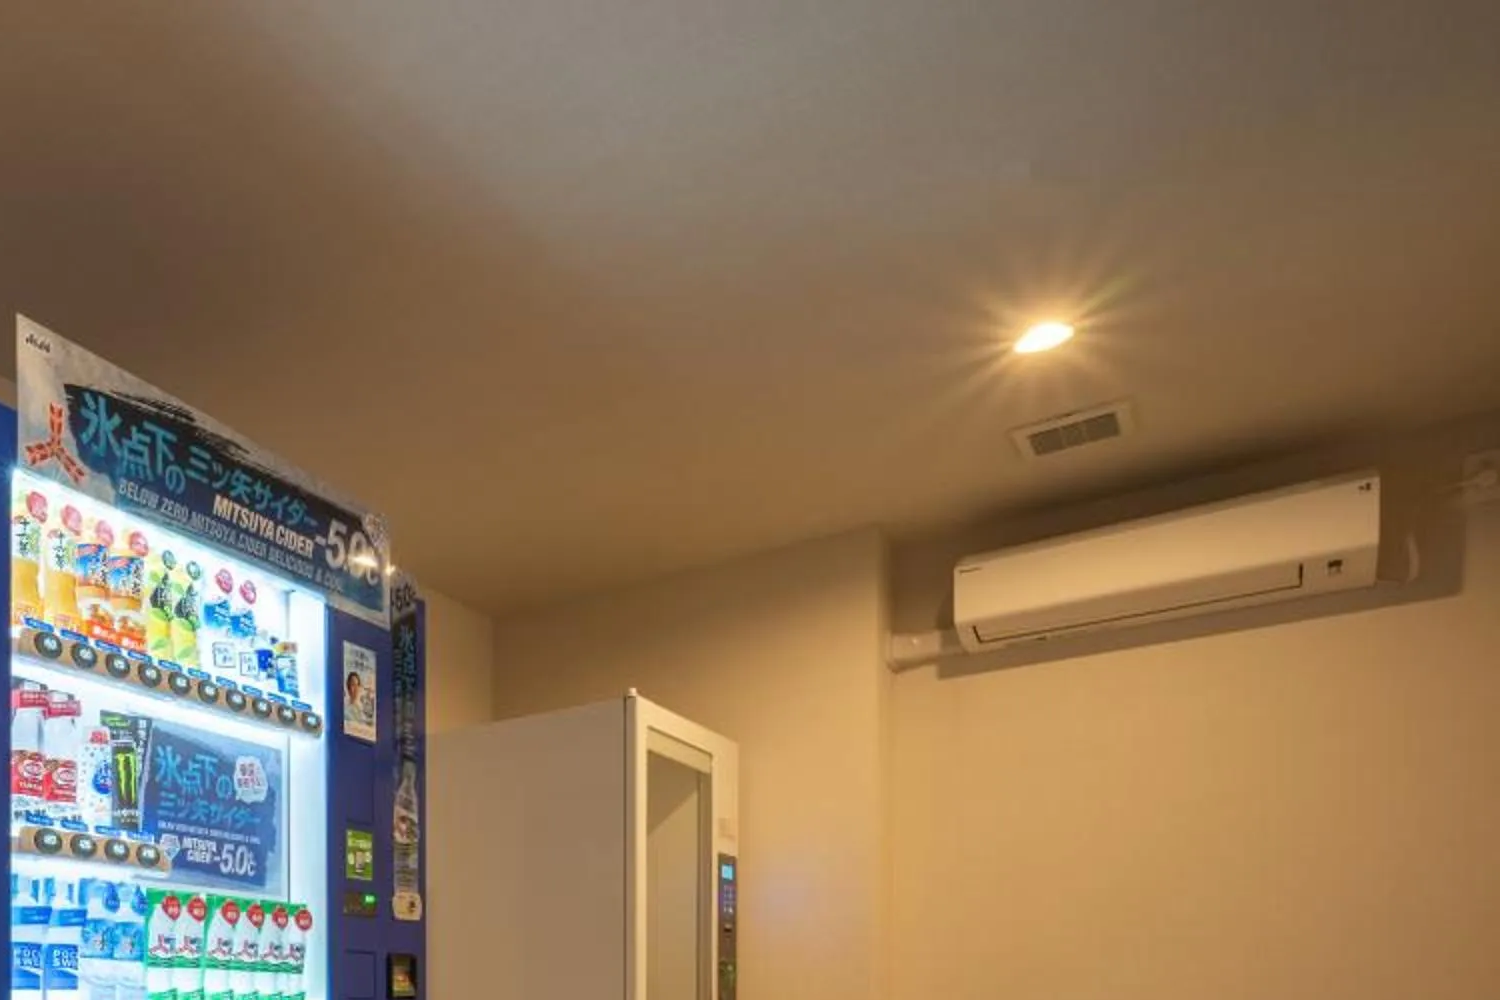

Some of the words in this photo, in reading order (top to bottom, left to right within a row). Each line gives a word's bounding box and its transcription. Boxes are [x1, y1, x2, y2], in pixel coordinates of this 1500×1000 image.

[80, 391, 187, 496] 氷点下の
[213, 494, 275, 542] MITSUYA
[275, 522, 315, 560] CIDER
[156, 744, 232, 800] 氷点下の
